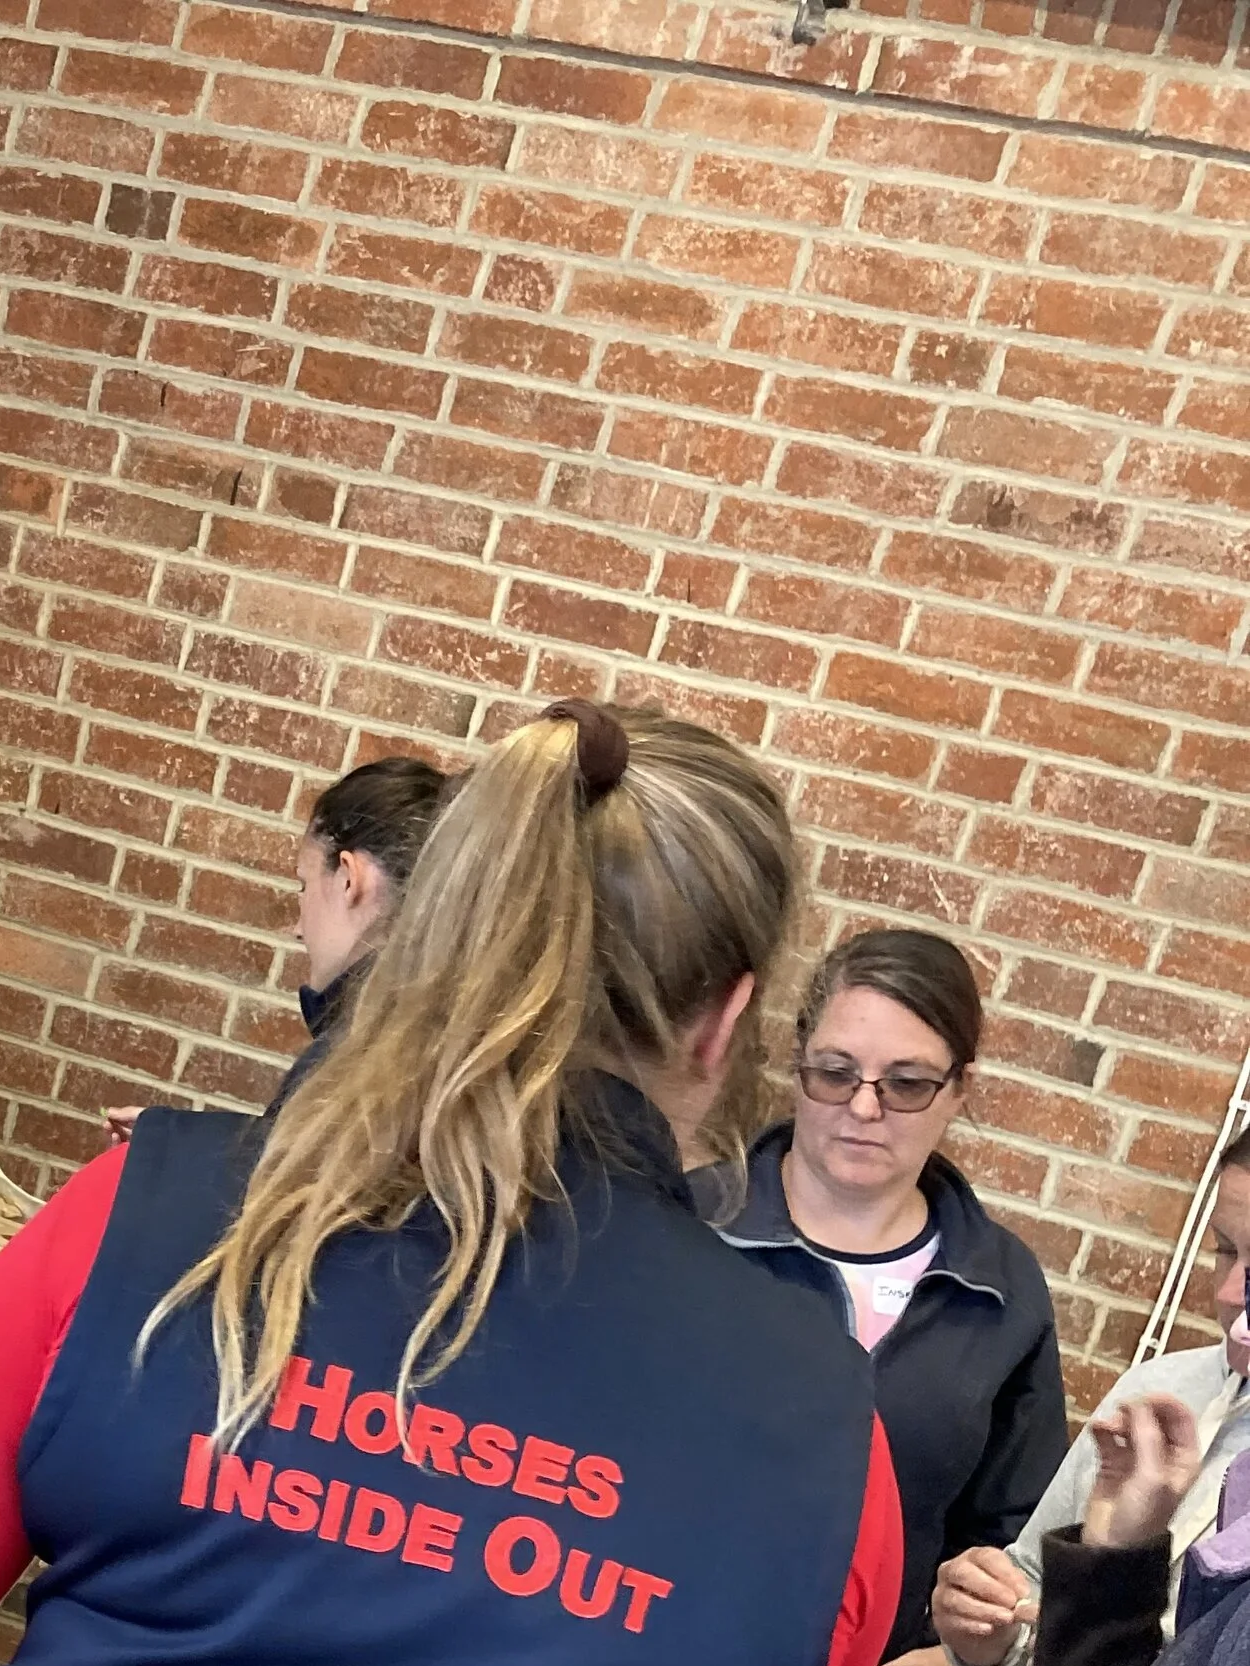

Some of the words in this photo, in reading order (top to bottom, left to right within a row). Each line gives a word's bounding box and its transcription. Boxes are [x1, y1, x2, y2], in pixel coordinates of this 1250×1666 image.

[270, 1355, 624, 1518] HORSES
[180, 1433, 464, 1572] INSIDE
[484, 1516, 674, 1633] OUT
